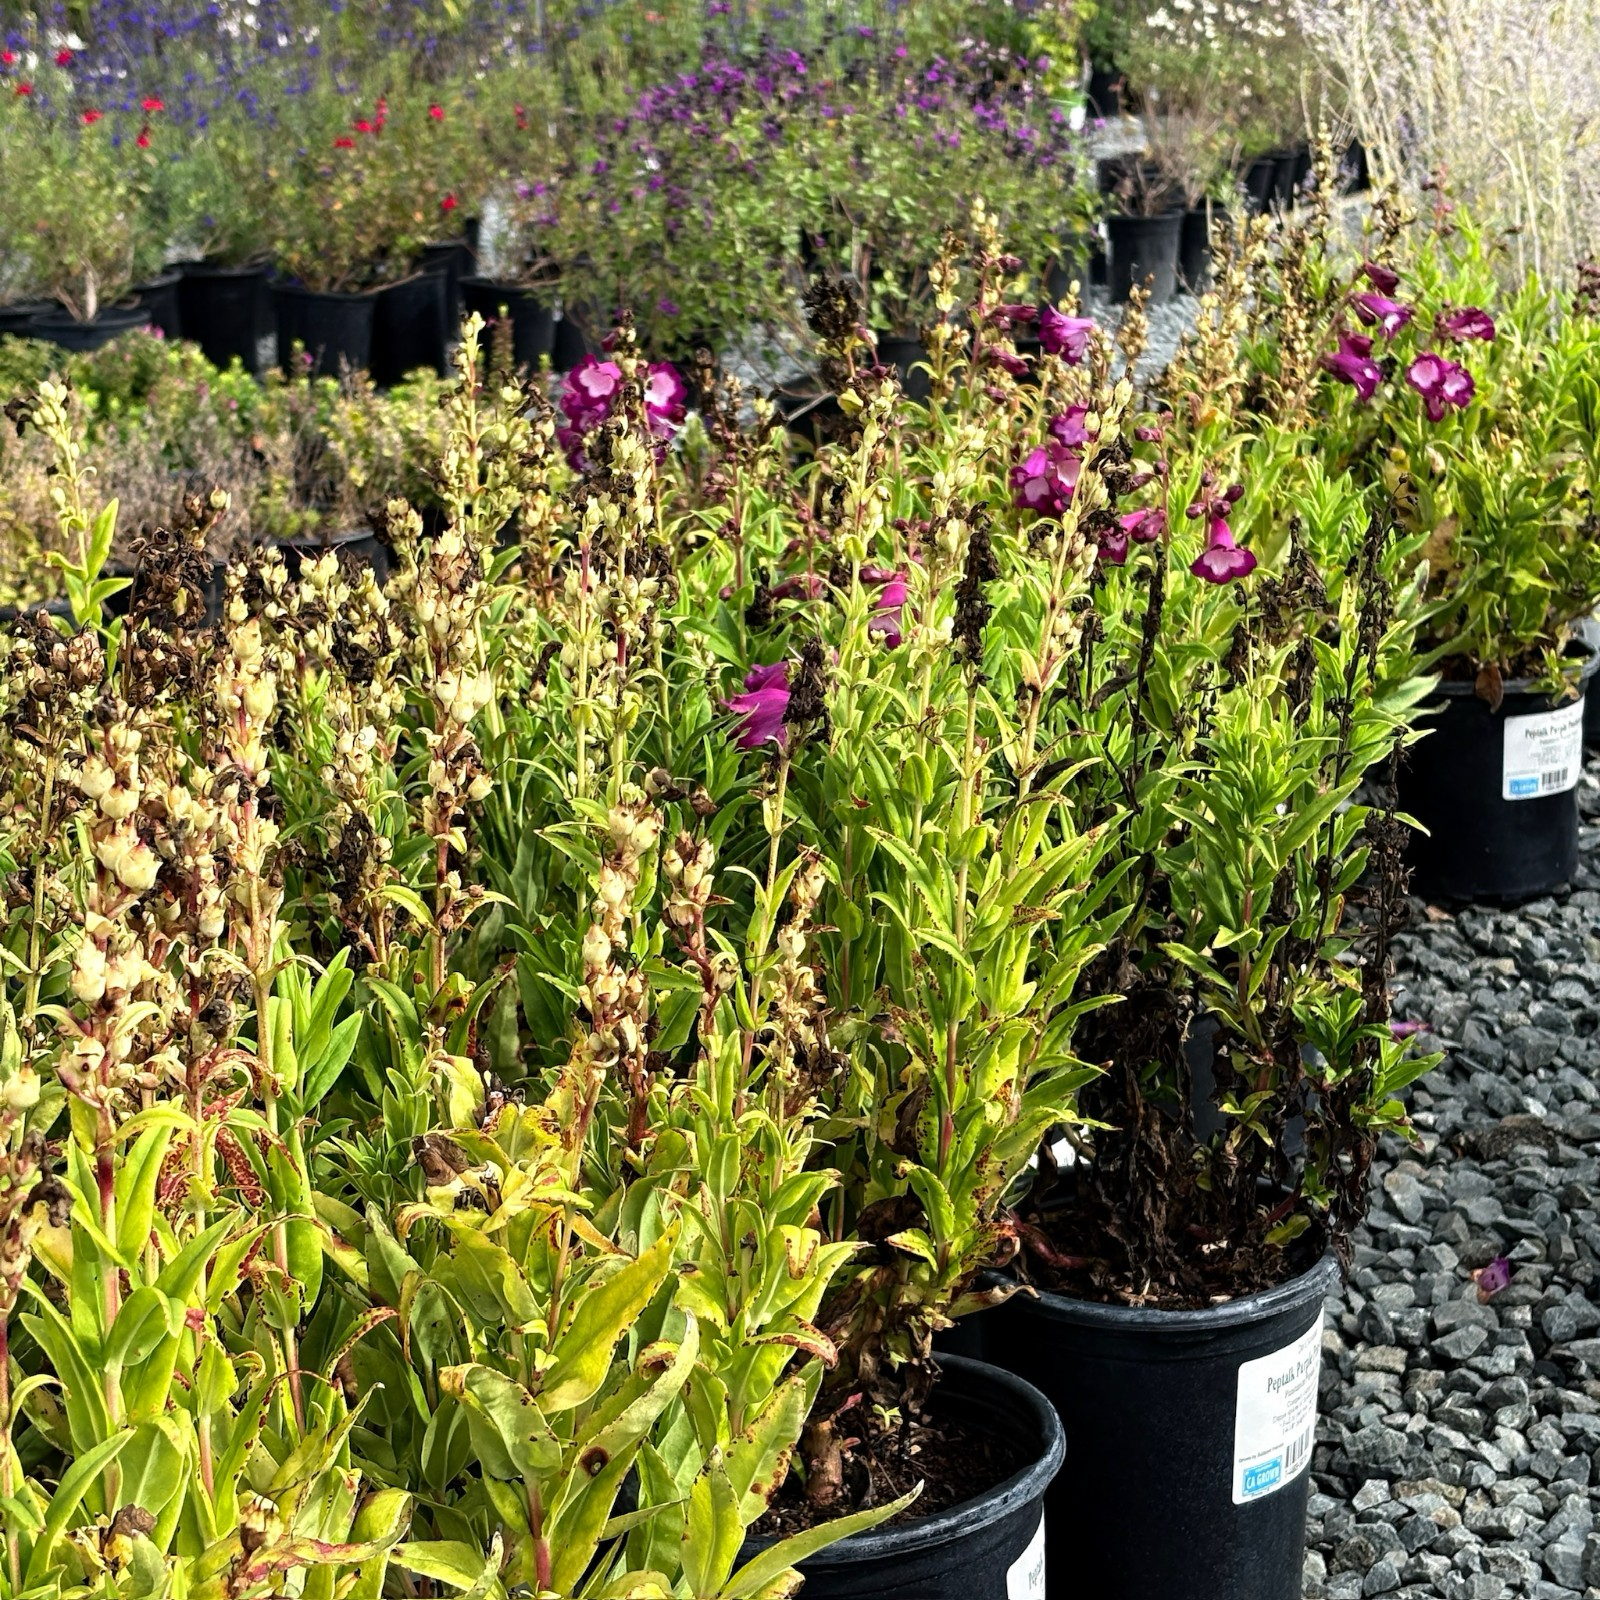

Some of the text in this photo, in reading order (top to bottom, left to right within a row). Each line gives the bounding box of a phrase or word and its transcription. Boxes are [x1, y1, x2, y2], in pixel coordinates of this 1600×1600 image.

[1267, 1366, 1295, 1394] Peptalk
[1246, 1475, 1256, 1490] CA
[1256, 1465, 1280, 1484] GROWN
